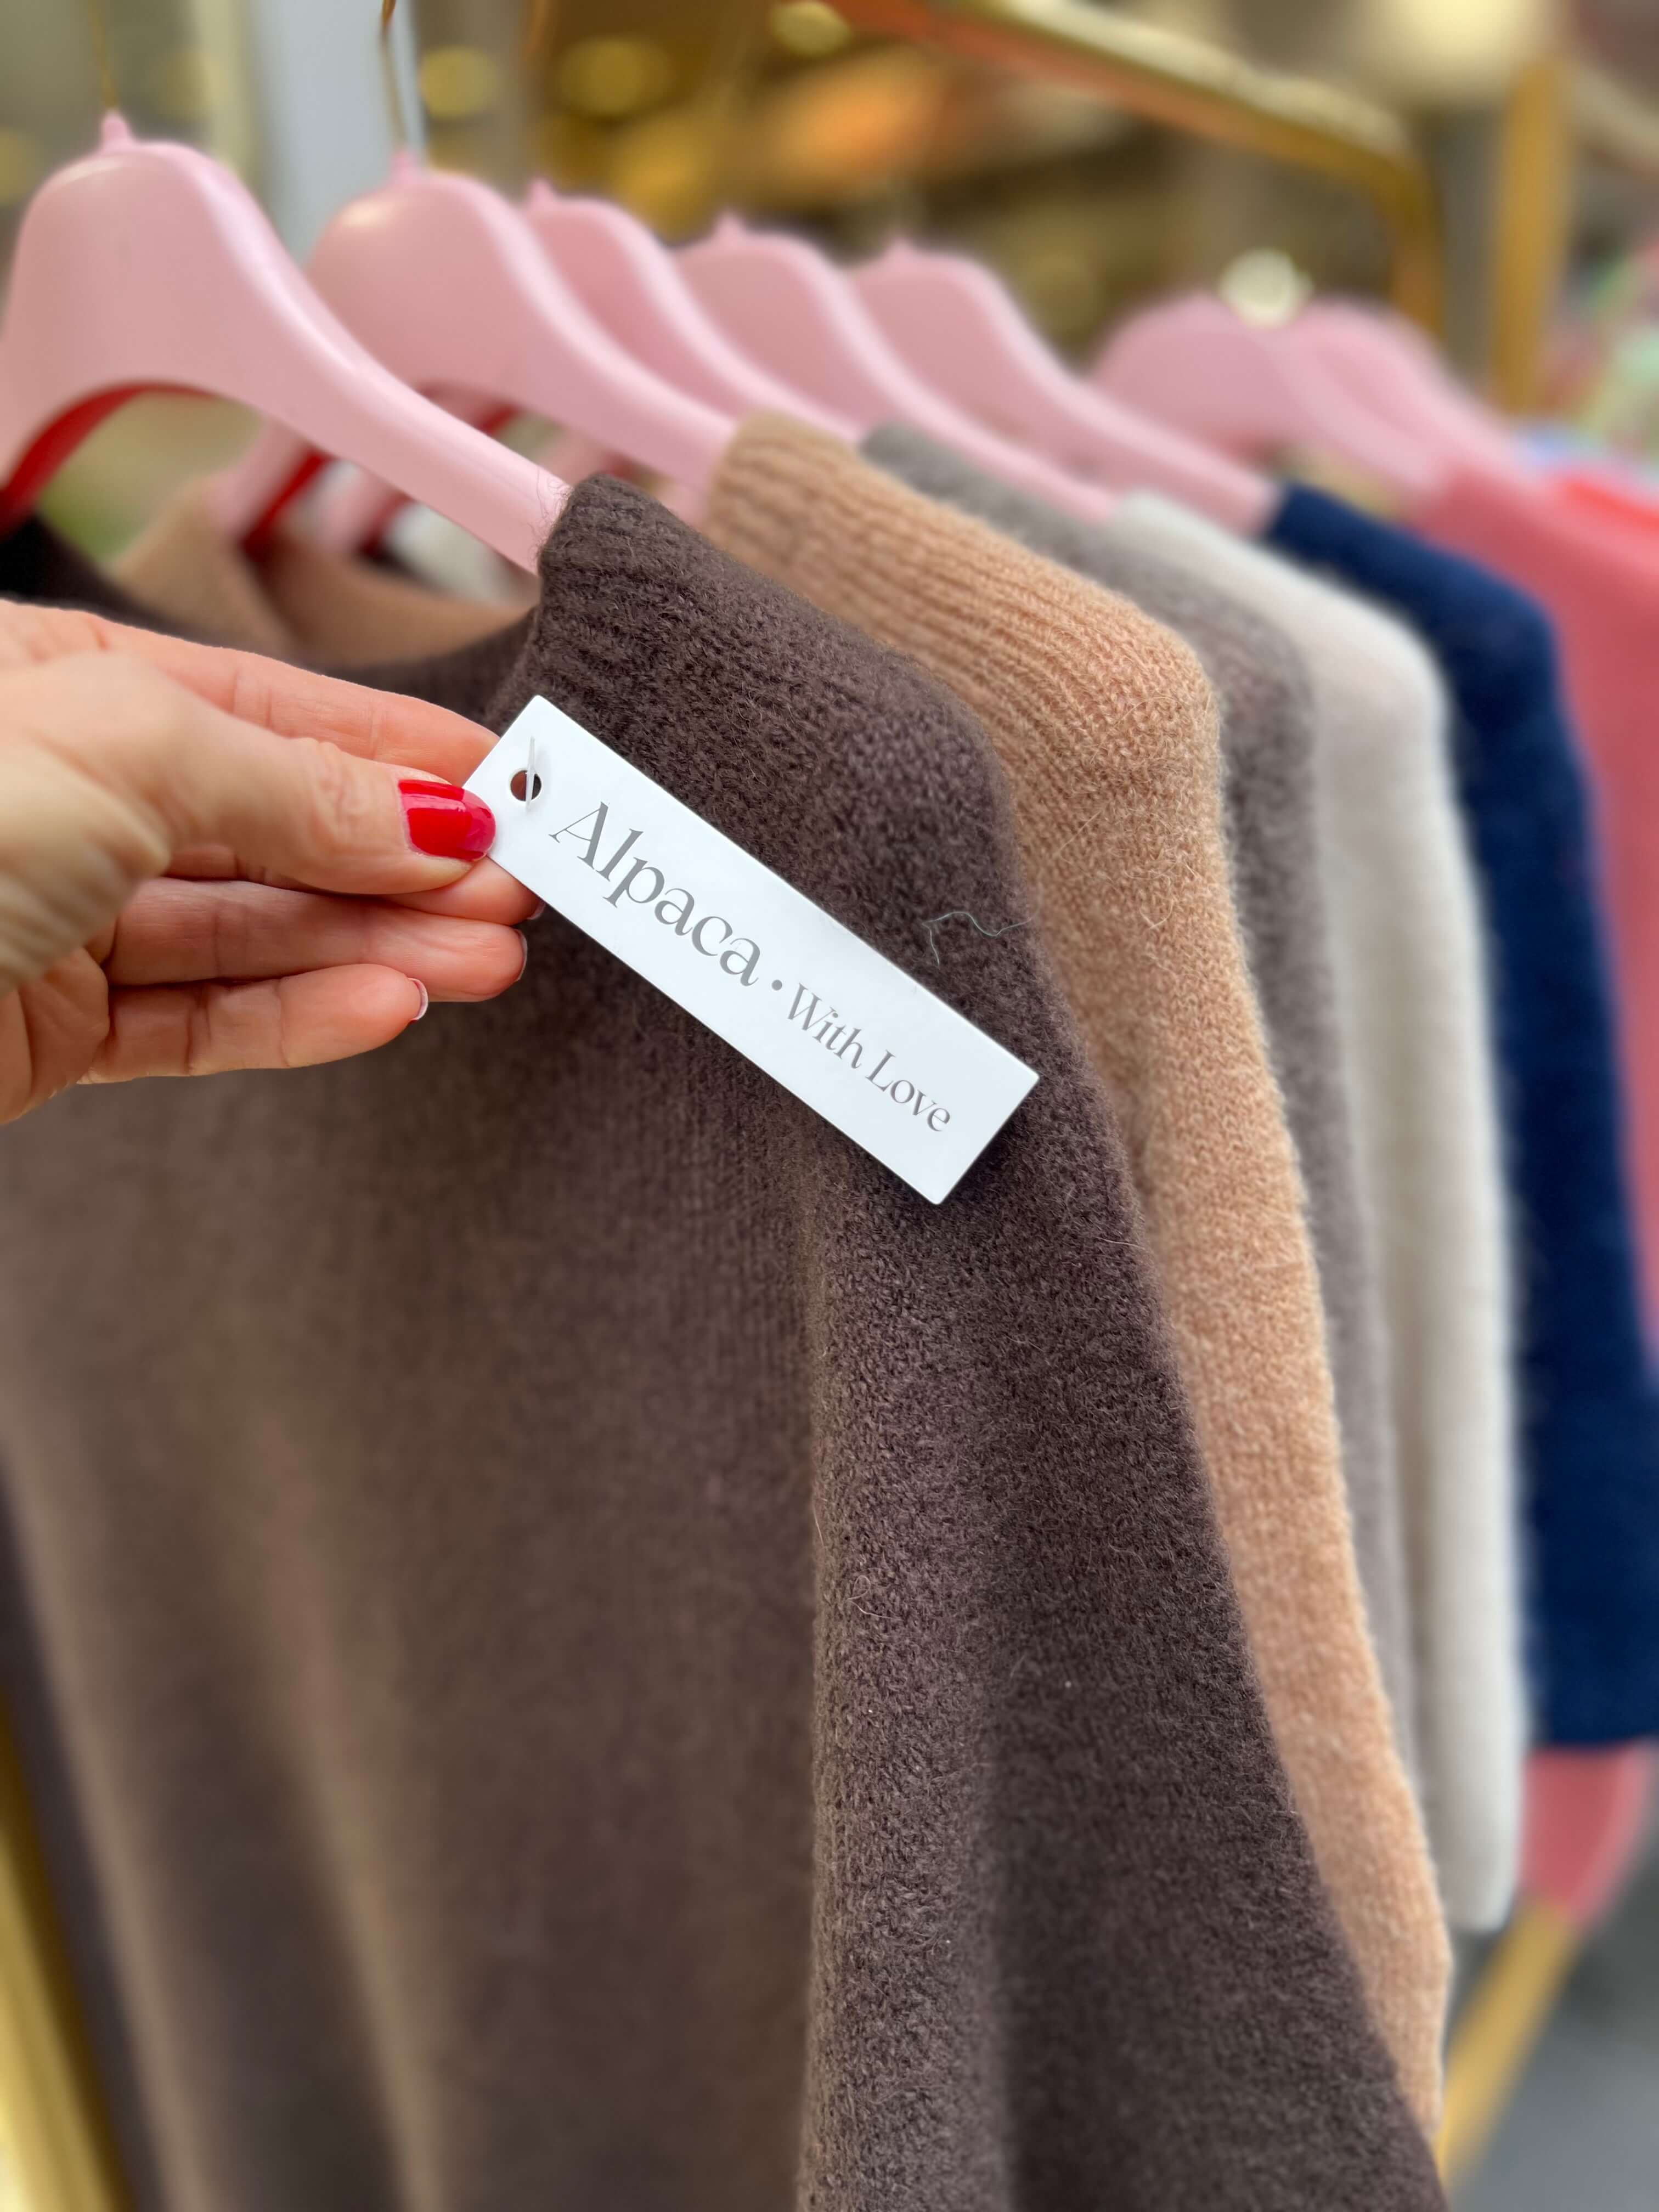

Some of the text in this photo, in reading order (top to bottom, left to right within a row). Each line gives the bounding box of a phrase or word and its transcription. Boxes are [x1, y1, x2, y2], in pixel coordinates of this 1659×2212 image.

[549, 800, 951, 1133] Alpaca With Love
